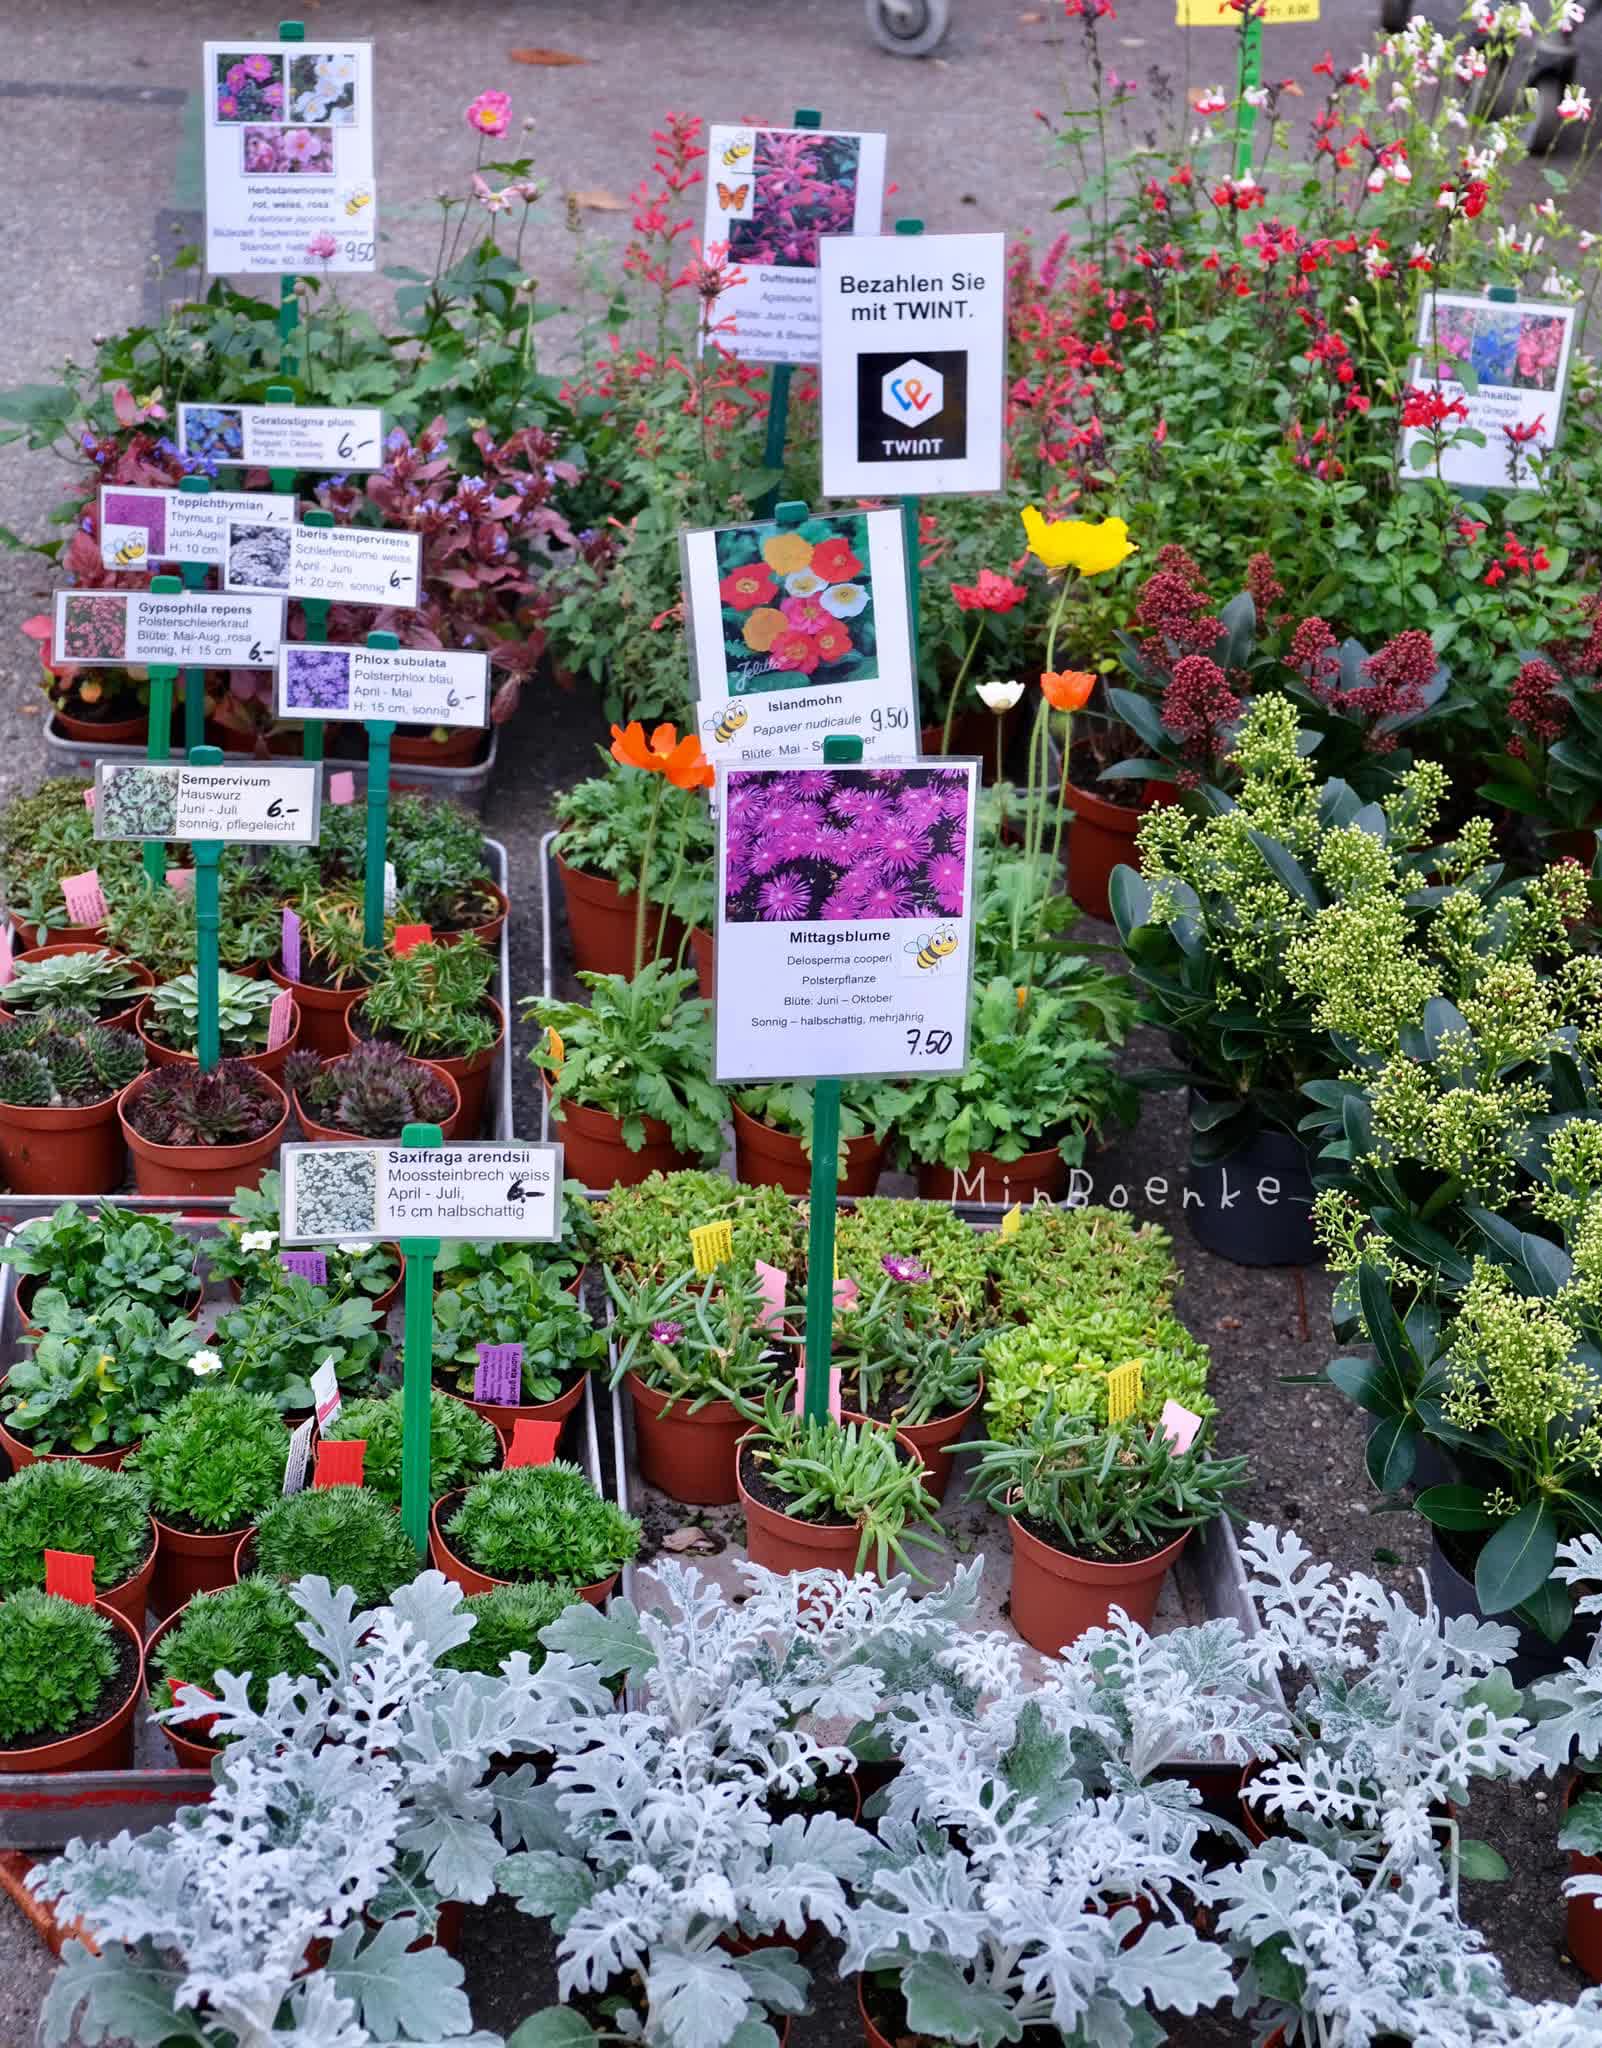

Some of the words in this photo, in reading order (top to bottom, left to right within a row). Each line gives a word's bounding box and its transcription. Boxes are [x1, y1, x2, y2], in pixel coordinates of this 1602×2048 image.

[840, 274, 944, 294] Bezahlen
[952, 273, 985, 292] Sie
[851, 303, 887, 321] mit
[894, 300, 974, 320] TWINT.
[882, 438, 944, 456] TWINT
[170, 495, 264, 512] Teppichthymian
[171, 511, 212, 524] Thymus
[296, 527, 329, 541] Iberis
[331, 533, 410, 548] sempervirens
[295, 559, 320, 571] April
[330, 561, 353, 575] Juni
[310, 576, 325, 588] 20
[138, 602, 208, 618] Gypsophila
[211, 606, 253, 617] repens
[137, 616, 249, 629] Polsterschleierkraut
[137, 630, 170, 642] Blüte:
[136, 645, 178, 657] sonnig,
[199, 645, 212, 656] 15
[215, 647, 232, 656] cm
[354, 654, 390, 666] Phlox
[393, 657, 447, 668] subulata
[354, 669, 425, 684] Polsterphlox
[428, 673, 454, 685] blau
[354, 686, 380, 699] April
[391, 687, 413, 698] Mai
[371, 703, 385, 713] 15
[412, 705, 451, 718] sonnig
[768, 694, 843, 713] Islandmohn
[753, 719, 803, 737] Papaver
[805, 714, 863, 731] nudicaule
[870, 706, 909, 732] 9.50
[741, 747, 773, 761] Blüte:
[778, 743, 801, 757] Mai
[182, 774, 271, 787] Sempervivum
[180, 789, 241, 801] Hauswurz
[179, 803, 206, 815] Juni
[216, 804, 238, 816] Juli
[178, 818, 223, 832] sonnig,
[226, 819, 296, 833] pflegeleicht
[789, 930, 891, 945] Mittagsblume
[787, 955, 851, 967] Delosperma
[853, 953, 893, 966] cooperi
[801, 974, 877, 987] Polsterpflanze
[783, 996, 814, 1007] Blüte:
[816, 995, 839, 1006] Juni
[851, 993, 893, 1005] Oktober
[751, 1016, 788, 1028] Sonnig
[800, 1014, 867, 1027] halbschattig,
[869, 1011, 925, 1025] mehrjährig
[906, 1028, 953, 1056] 7.50
[388, 1151, 463, 1166] Saxifraga
[467, 1151, 530, 1164] arendsii
[388, 1168, 504, 1182] Moossteinbrech
[509, 1169, 550, 1182] weiss
[387, 1187, 422, 1201] April
[435, 1187, 465, 1201] Juli,
[388, 1205, 407, 1217] 15
[410, 1207, 433, 1218] cm
[437, 1204, 525, 1220] halbschattig
